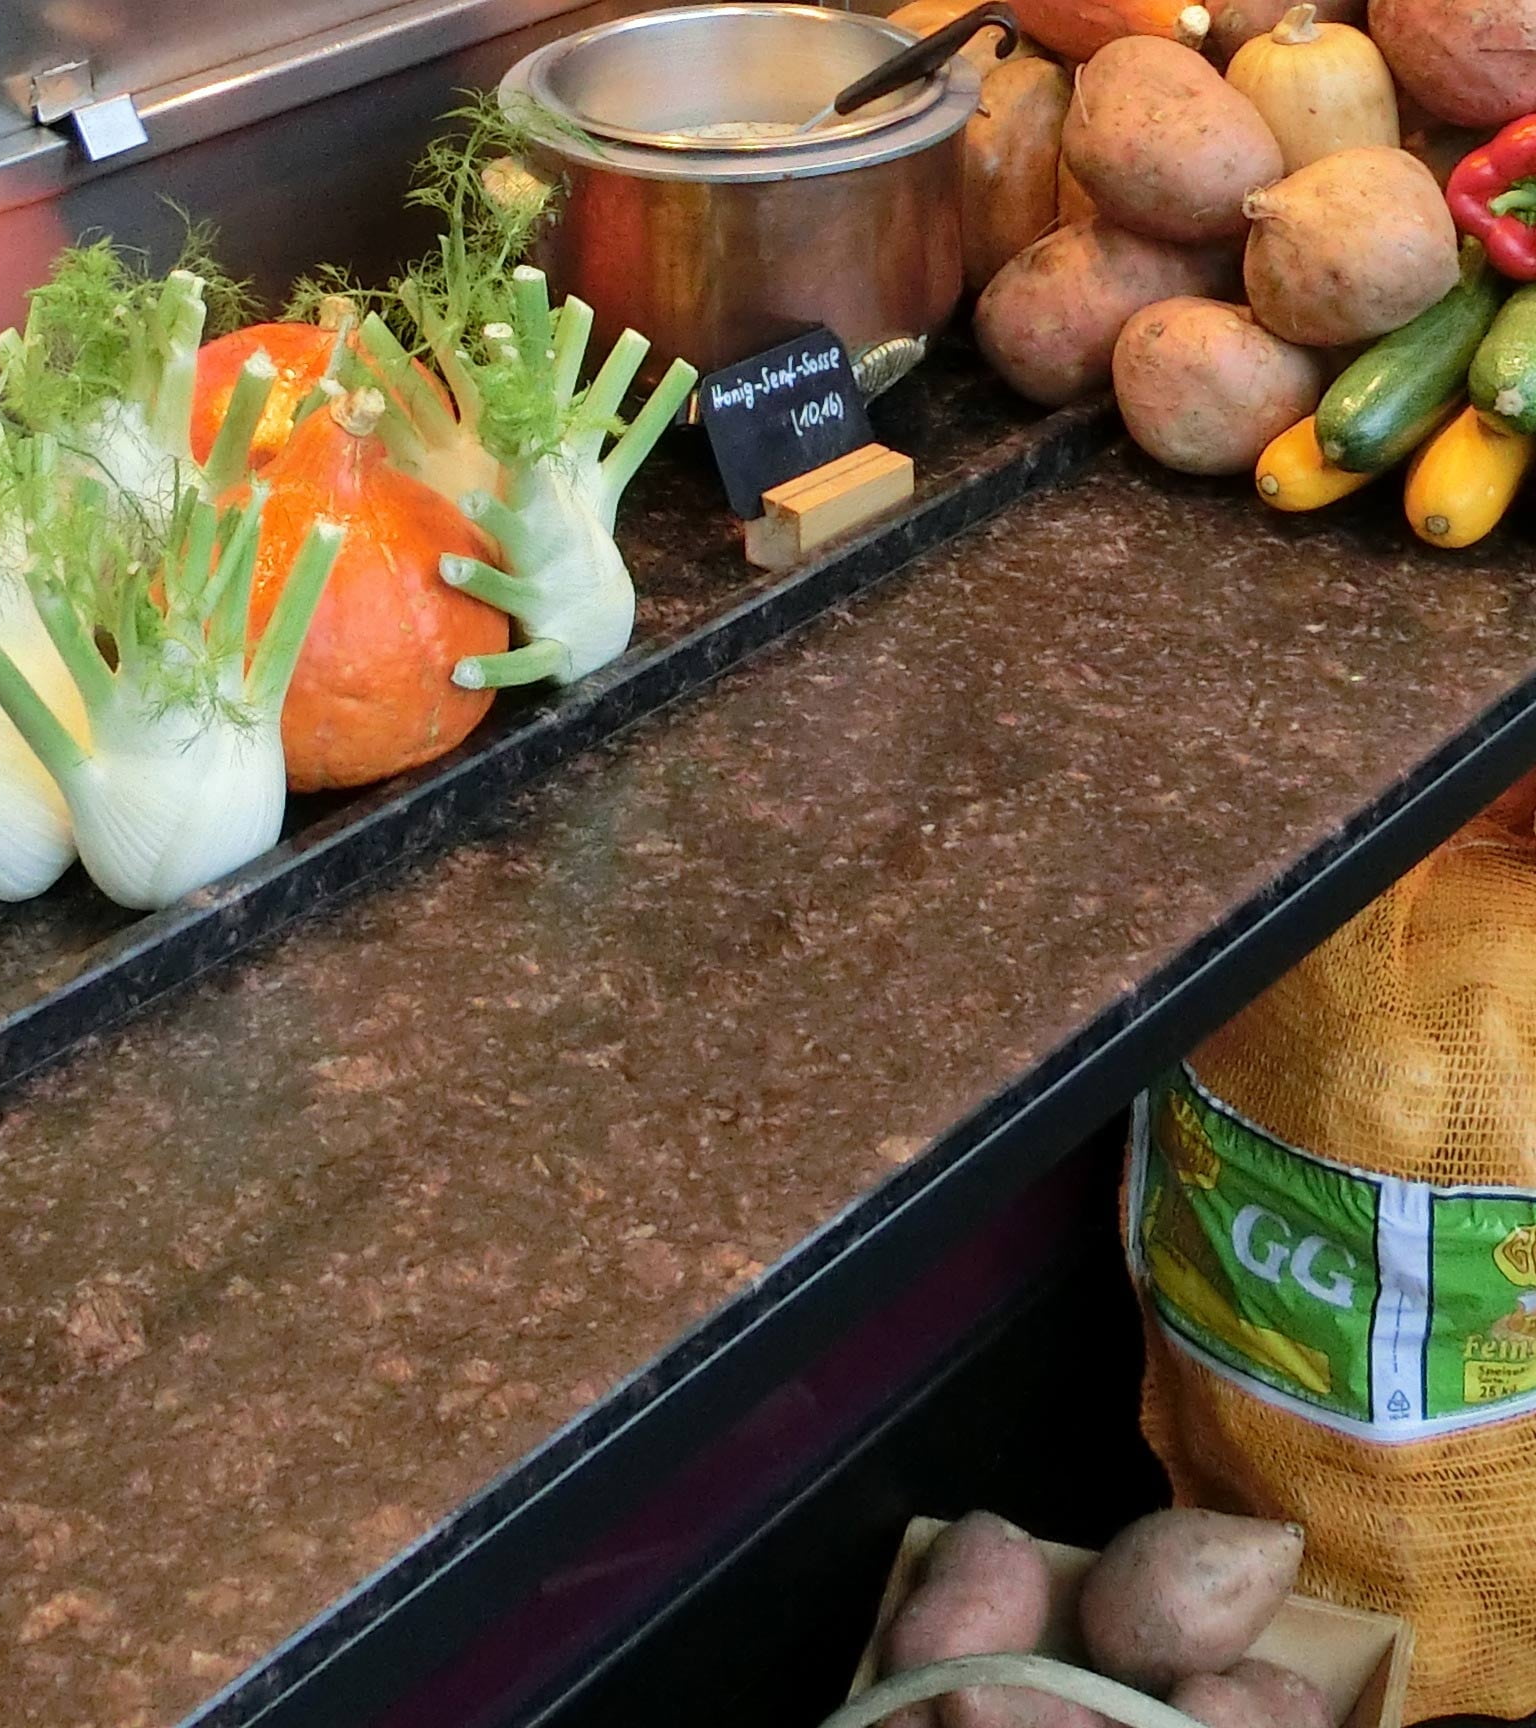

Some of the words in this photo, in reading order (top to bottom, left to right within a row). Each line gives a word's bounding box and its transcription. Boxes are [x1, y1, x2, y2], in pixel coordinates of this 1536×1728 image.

[711, 346, 841, 410] Honig-Senf-Sosse
[1232, 1204, 1356, 1308] GG
[1479, 1385, 1497, 1399] 25
